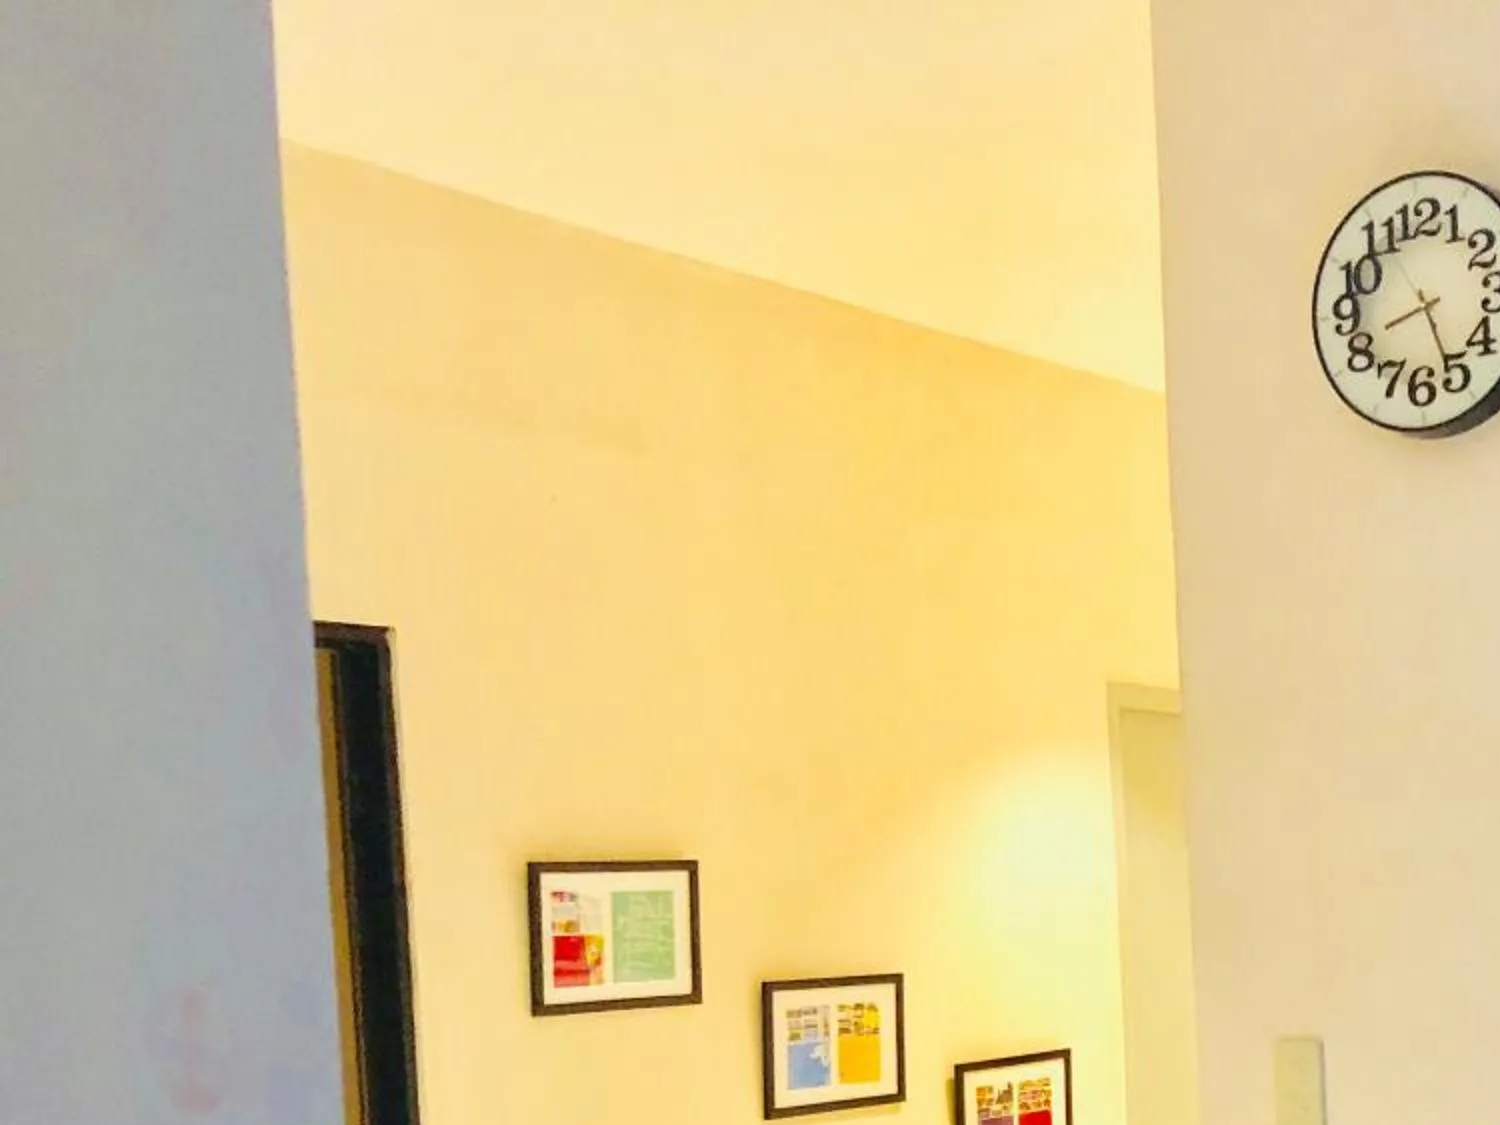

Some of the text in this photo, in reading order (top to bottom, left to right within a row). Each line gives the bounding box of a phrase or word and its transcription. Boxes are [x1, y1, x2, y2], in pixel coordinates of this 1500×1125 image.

[1361, 217, 1401, 256] 11
[1395, 197, 1443, 242] 12
[1444, 204, 1466, 244] 1
[1467, 228, 1497, 271] 2
[1339, 254, 1383, 298] 10
[1332, 292, 1361, 336] 9
[1347, 332, 1375, 373] 8
[1465, 315, 1498, 357] 4
[1376, 357, 1407, 399] 7
[1407, 365, 1437, 407] 6
[1441, 350, 1471, 393] 5
